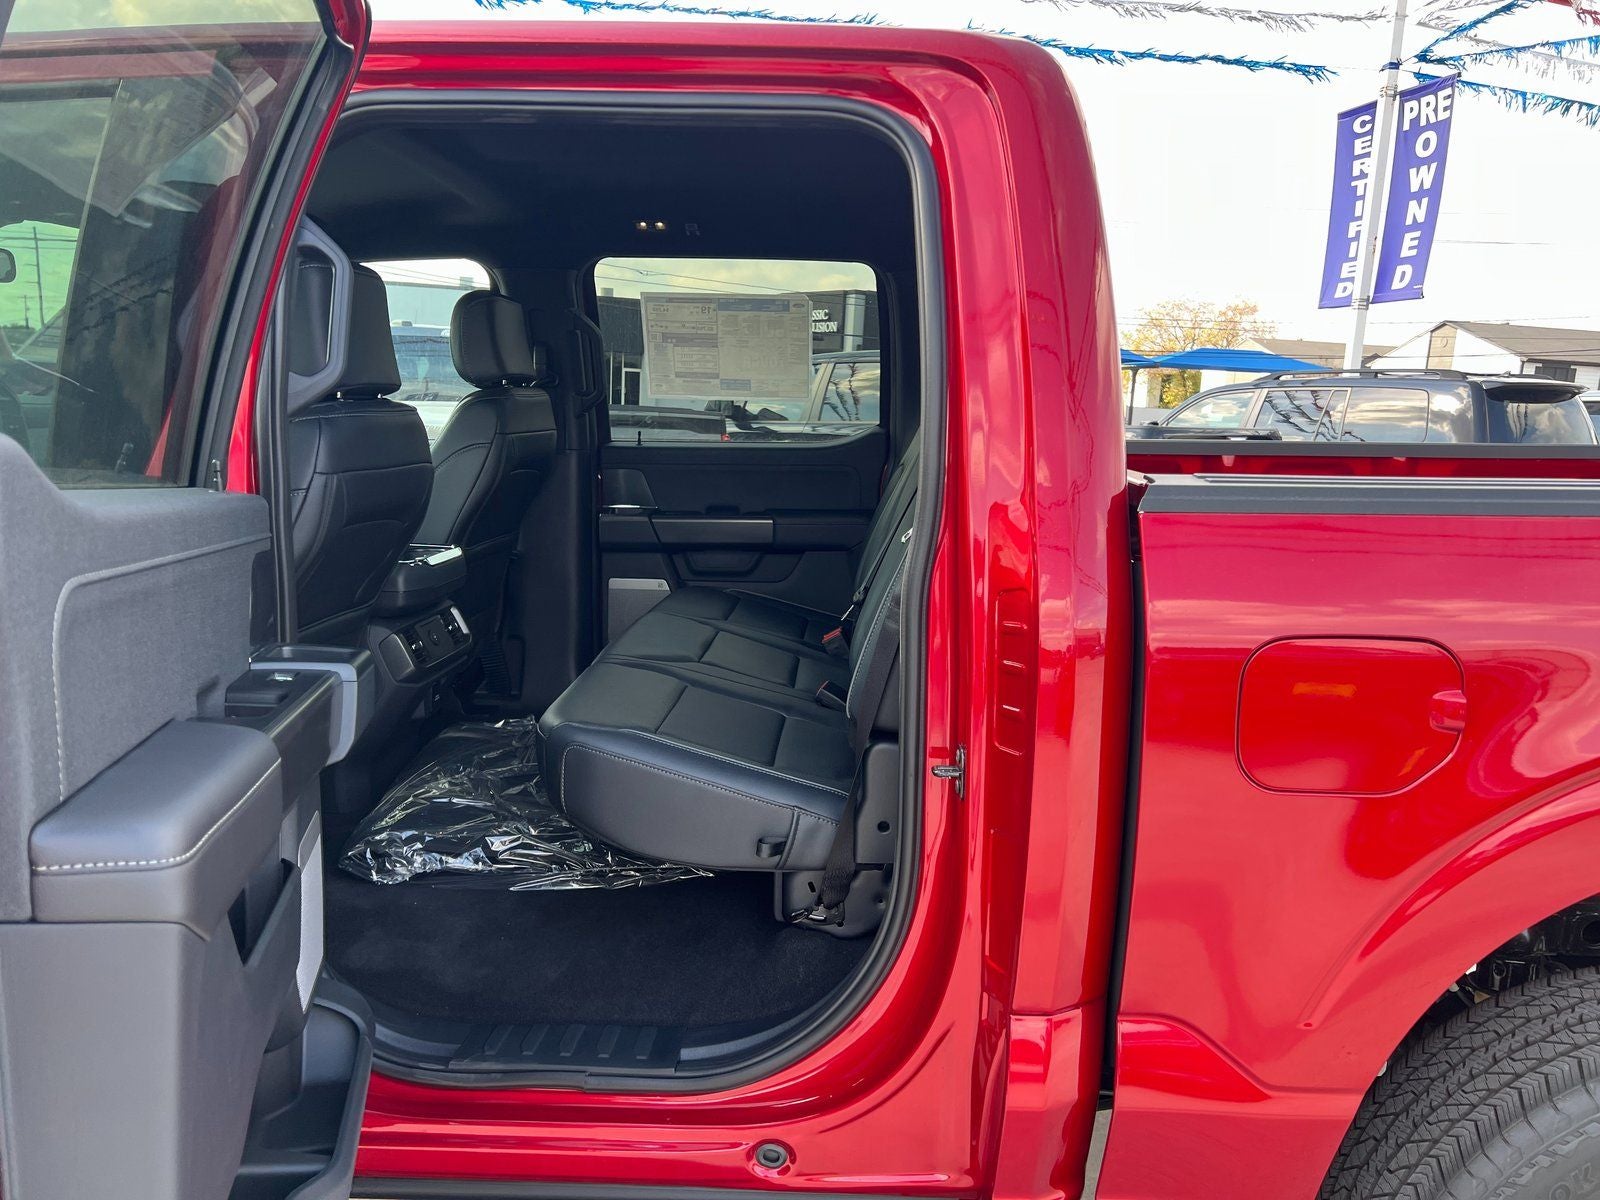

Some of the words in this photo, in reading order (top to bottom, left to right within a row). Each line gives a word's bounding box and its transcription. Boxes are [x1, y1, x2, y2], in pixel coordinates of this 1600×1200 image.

[1402, 87, 1453, 132] PRE
[1333, 114, 1373, 299] CERTIFIED
[1390, 129, 1438, 291] OWNED
[811, 309, 829, 320] SSIC
